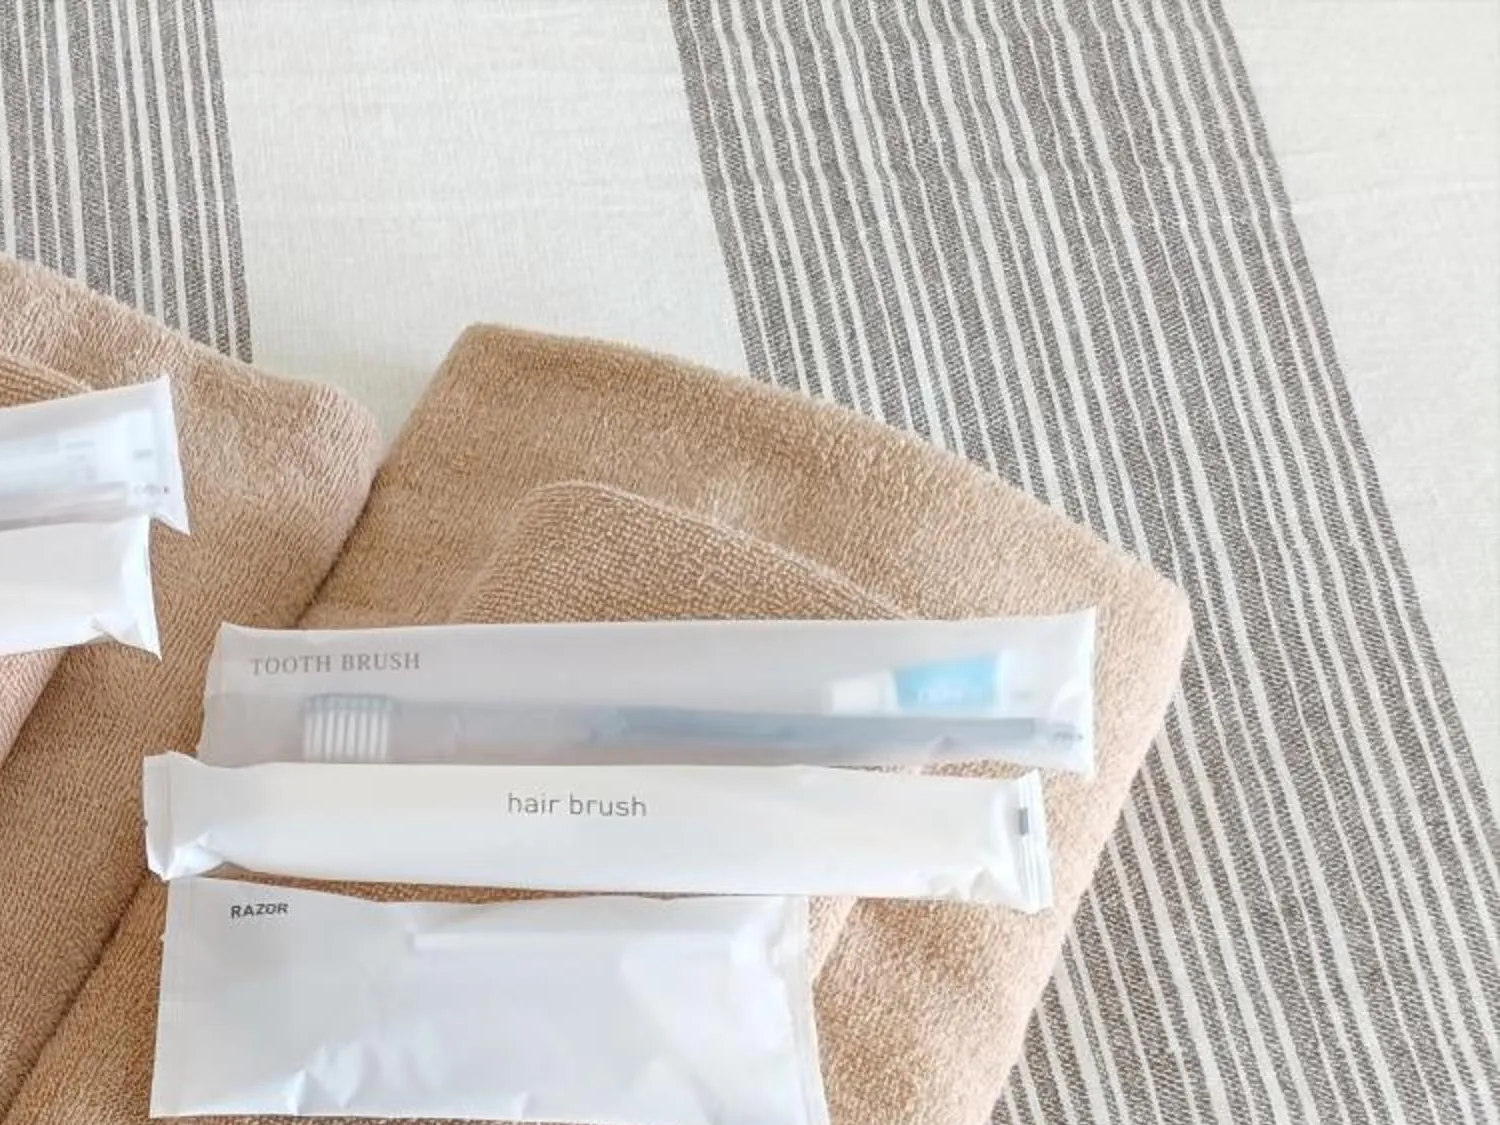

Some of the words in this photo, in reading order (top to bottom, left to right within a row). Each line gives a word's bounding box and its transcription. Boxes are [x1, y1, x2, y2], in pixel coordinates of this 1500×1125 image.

[250, 654, 332, 676] TOOTH
[341, 652, 421, 673] BRUSH
[506, 791, 561, 816] hair
[568, 792, 648, 818] brush
[230, 901, 290, 920] RAZOR
